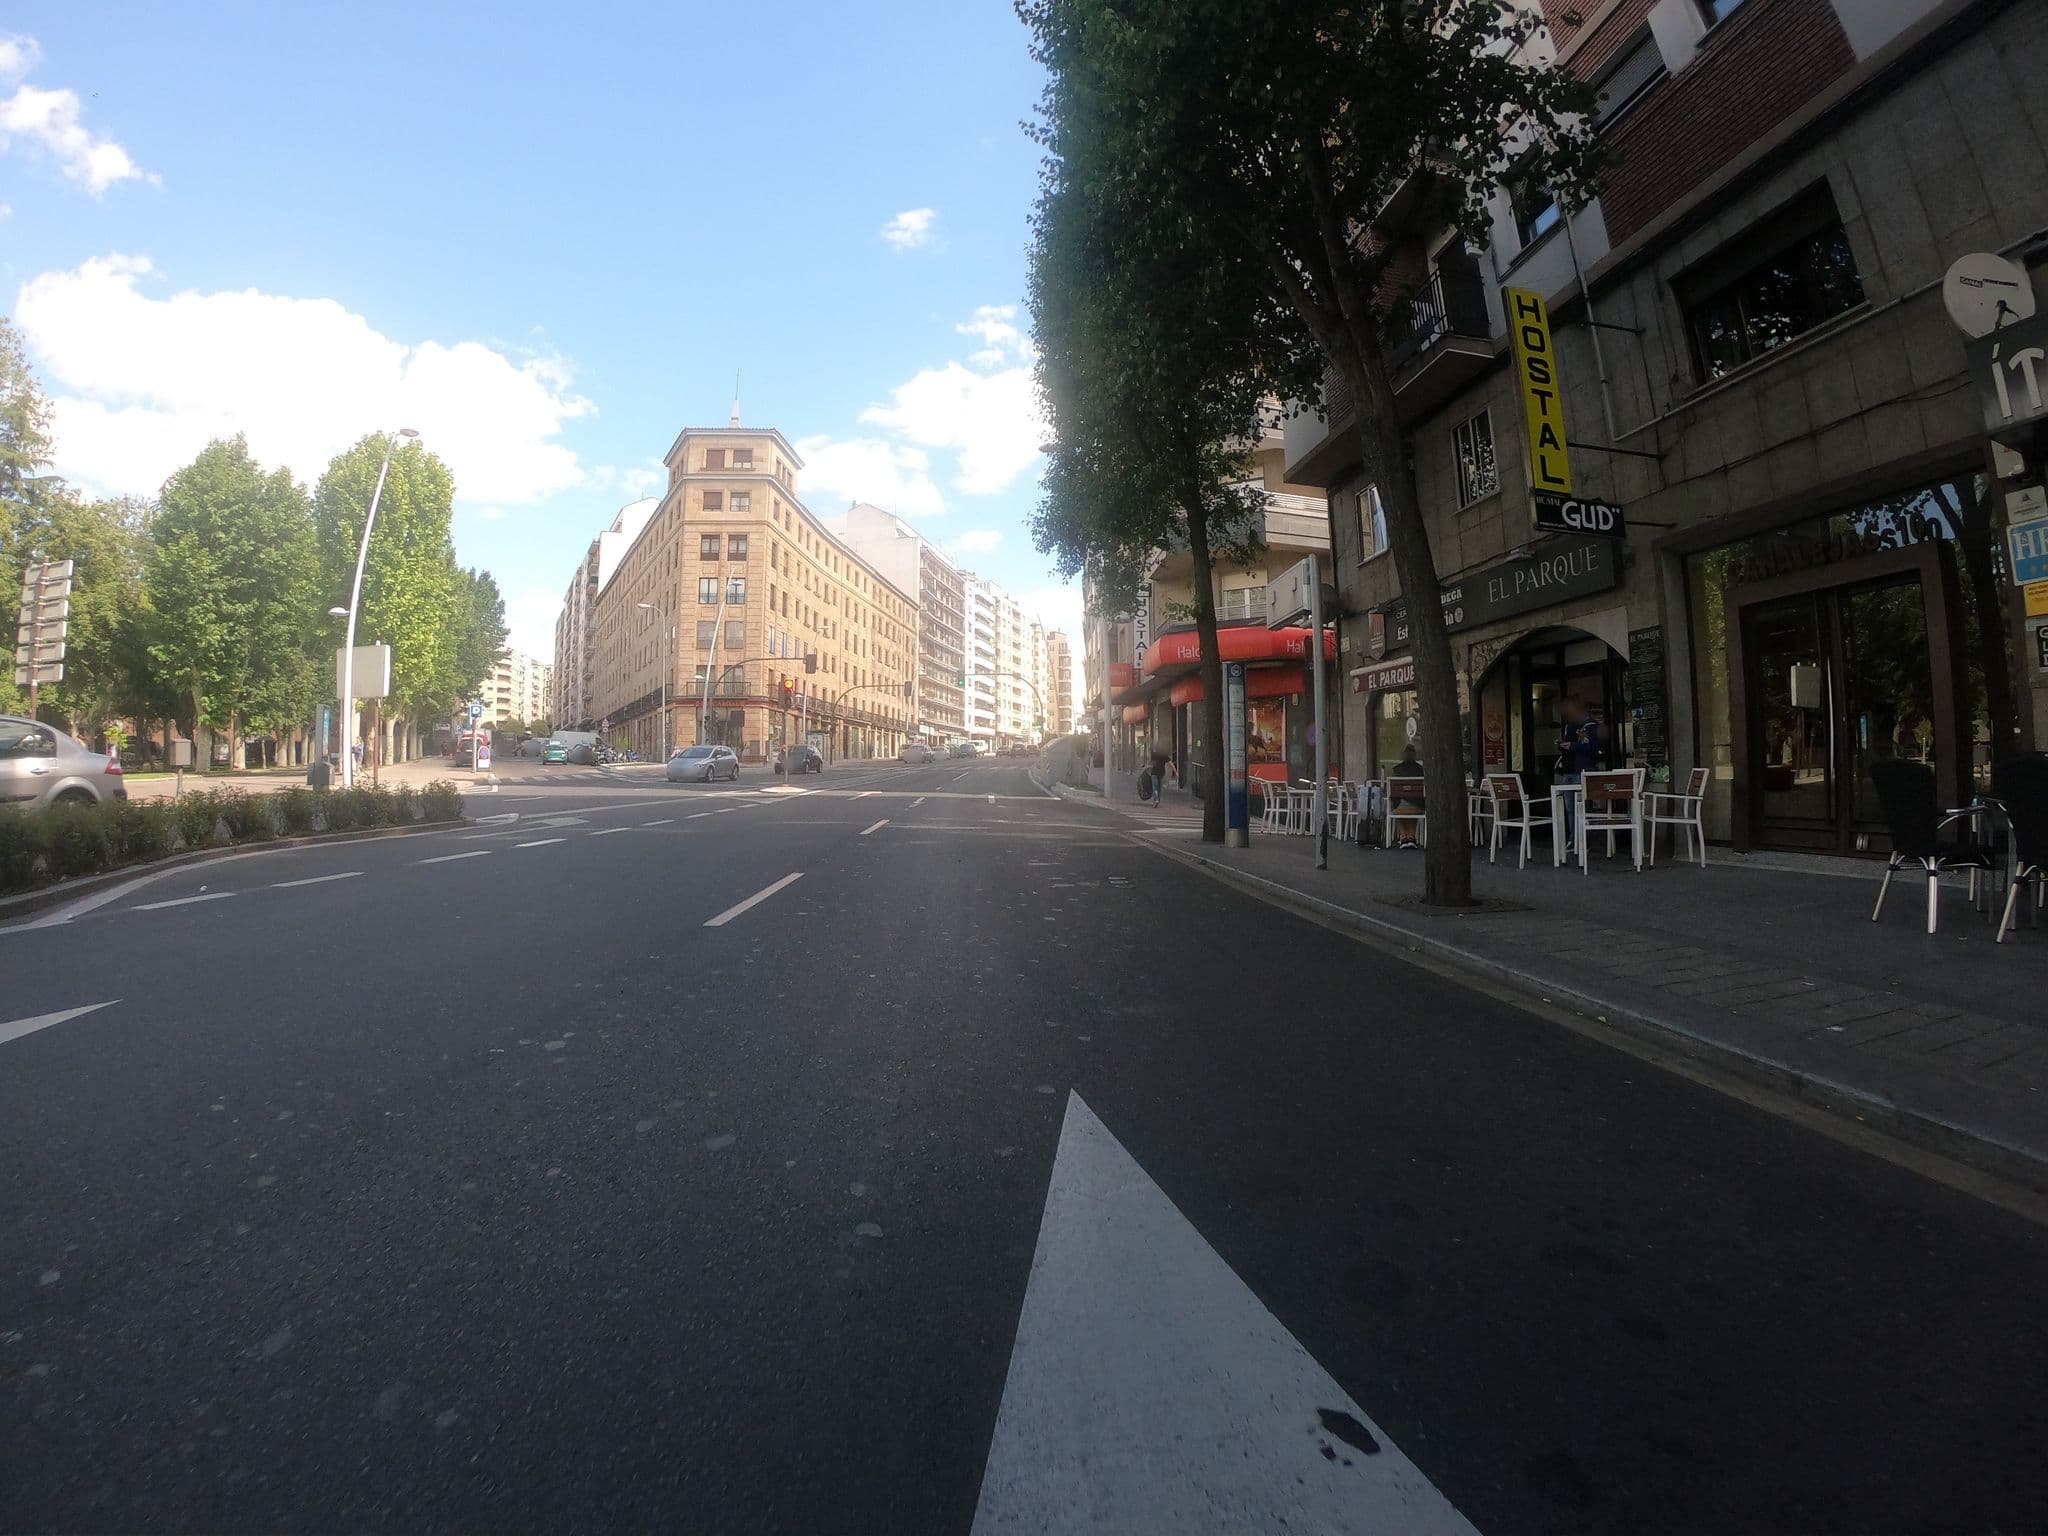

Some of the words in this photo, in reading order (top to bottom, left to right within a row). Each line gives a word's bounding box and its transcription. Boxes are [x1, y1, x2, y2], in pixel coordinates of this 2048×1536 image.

[1516, 295, 1565, 485] HOSTAL
[1487, 578, 1511, 604] EL
[1514, 544, 1600, 595] PARQUE
[1367, 674, 1377, 689] EL
[1379, 664, 1416, 687] PARQUE
